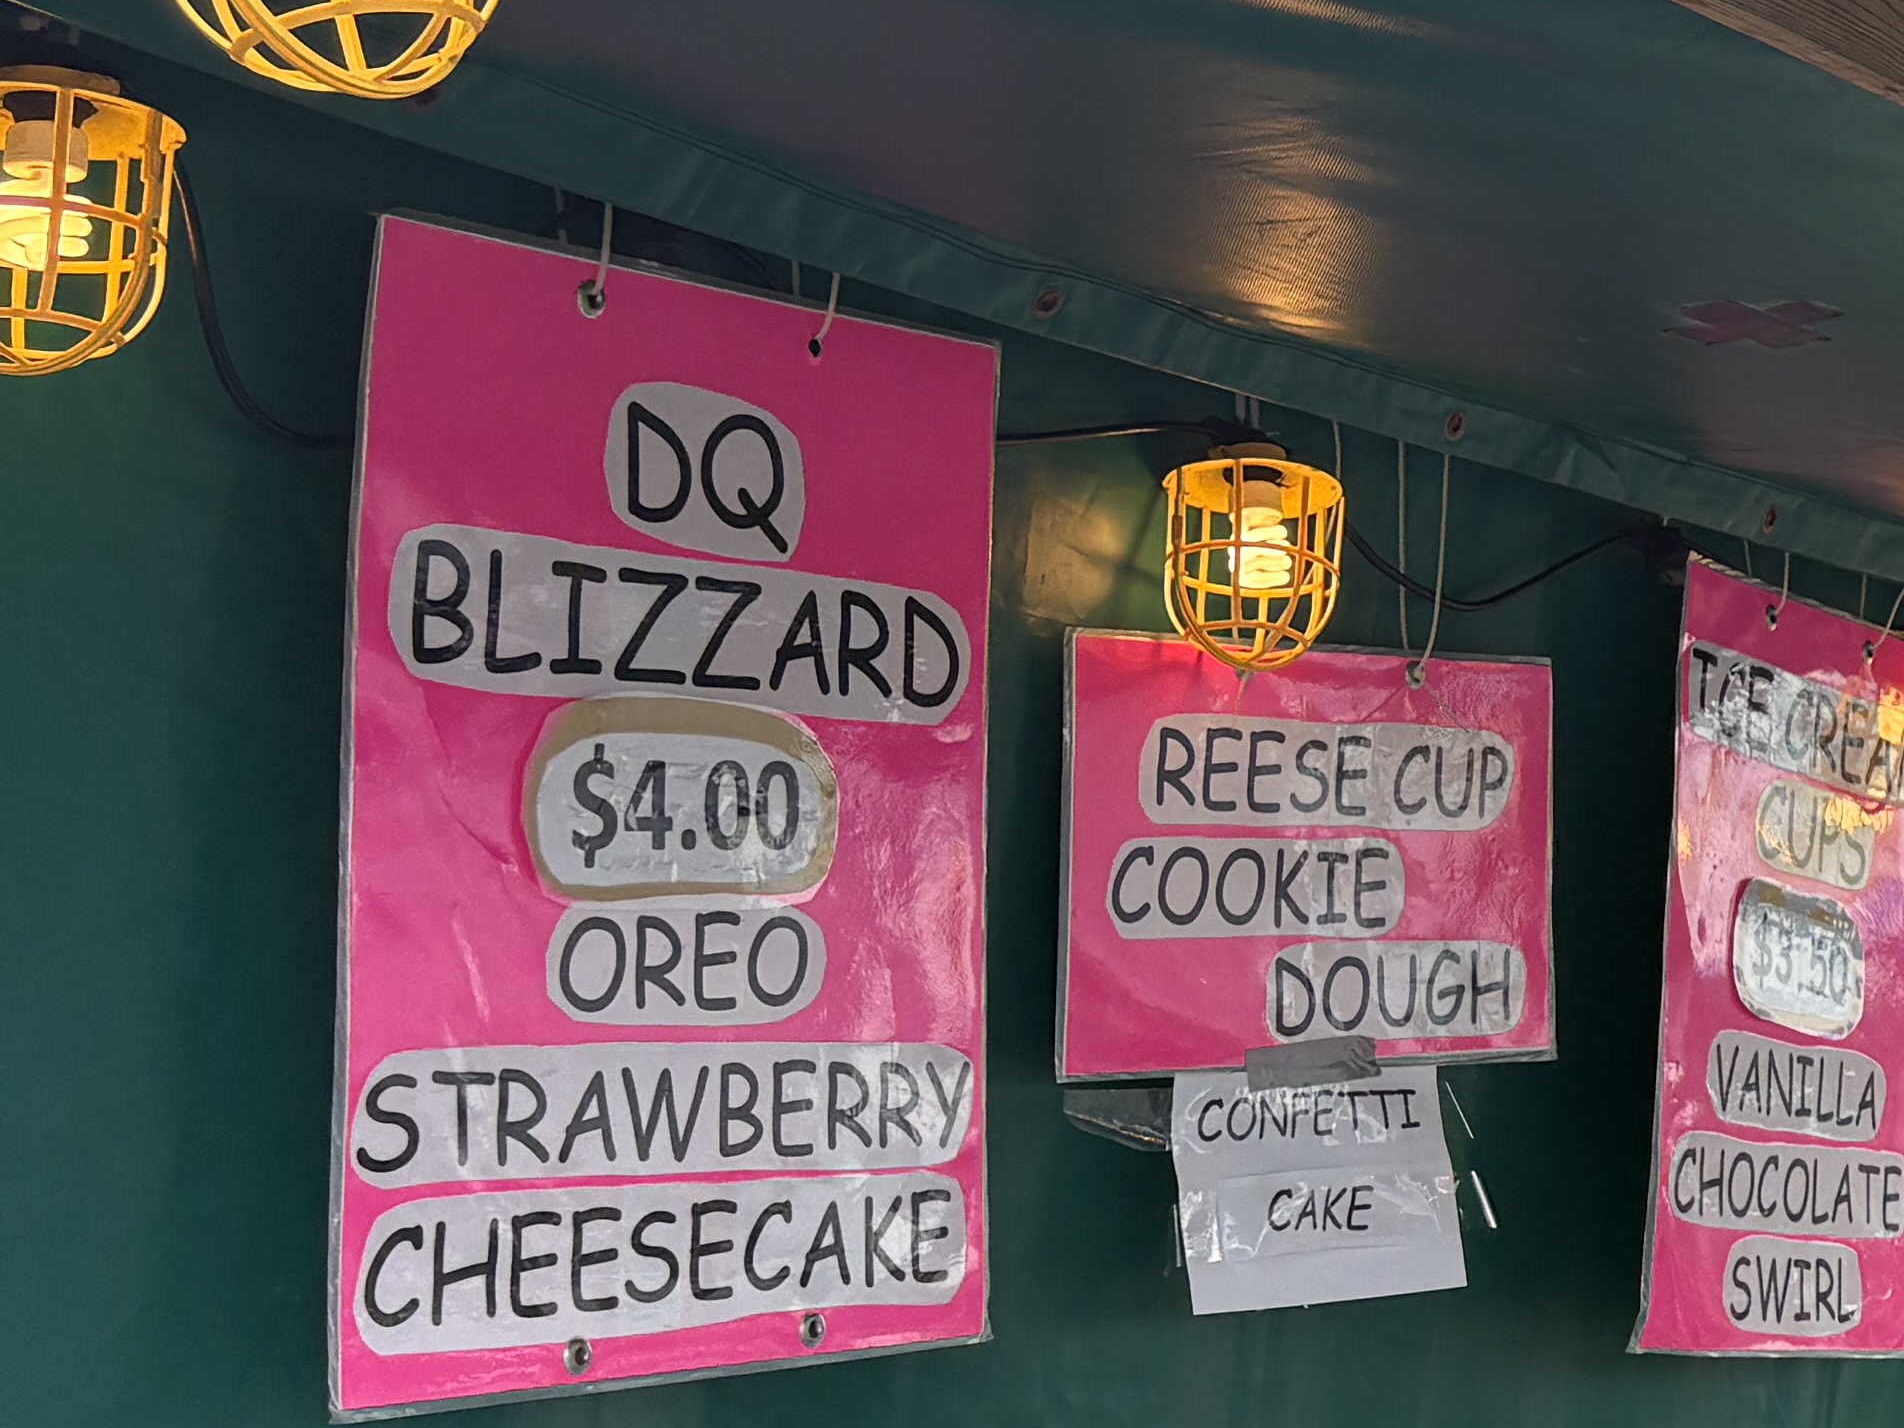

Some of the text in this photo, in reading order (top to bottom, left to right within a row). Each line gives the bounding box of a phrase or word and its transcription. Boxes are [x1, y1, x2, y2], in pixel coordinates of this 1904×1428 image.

[627, 401, 788, 554] DQ
[409, 539, 959, 709] BLIZZARD
[1692, 647, 1774, 755] ICE
[570, 743, 800, 868] $4.00
[1155, 727, 1509, 819] REESE CUP
[1757, 781, 1866, 886] CUPS
[1111, 845, 1388, 929] COOKIE
[559, 910, 806, 1013] OREO
[1275, 948, 1511, 1035] DOUGH
[353, 1059, 971, 1176] STRAWBERRY
[1198, 1089, 1419, 1143] CONFETTI
[1715, 1043, 1877, 1132] VANILLA
[1268, 1184, 1374, 1233] CAKE
[1675, 1146, 1902, 1232] CHOCOLATE
[362, 1190, 952, 1328] CHEESECAKE
[1731, 1255, 1855, 1325] SWIRL
